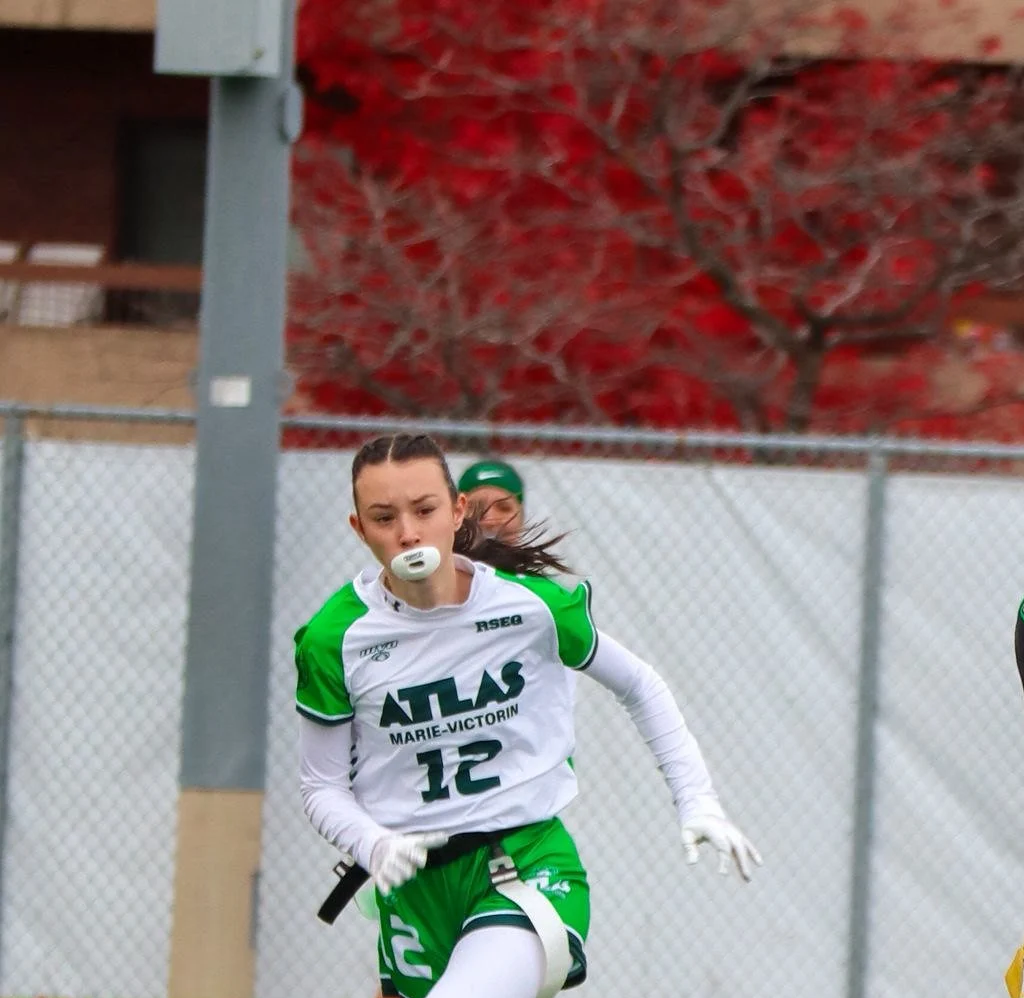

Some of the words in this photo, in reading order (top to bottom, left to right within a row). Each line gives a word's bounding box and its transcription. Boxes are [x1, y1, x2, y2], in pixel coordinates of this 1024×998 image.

[475, 614, 523, 632] RSEQ
[379, 661, 525, 727] ATLAS
[389, 703, 519, 746] MARIE-VICTORIN
[416, 739, 502, 802] 12
